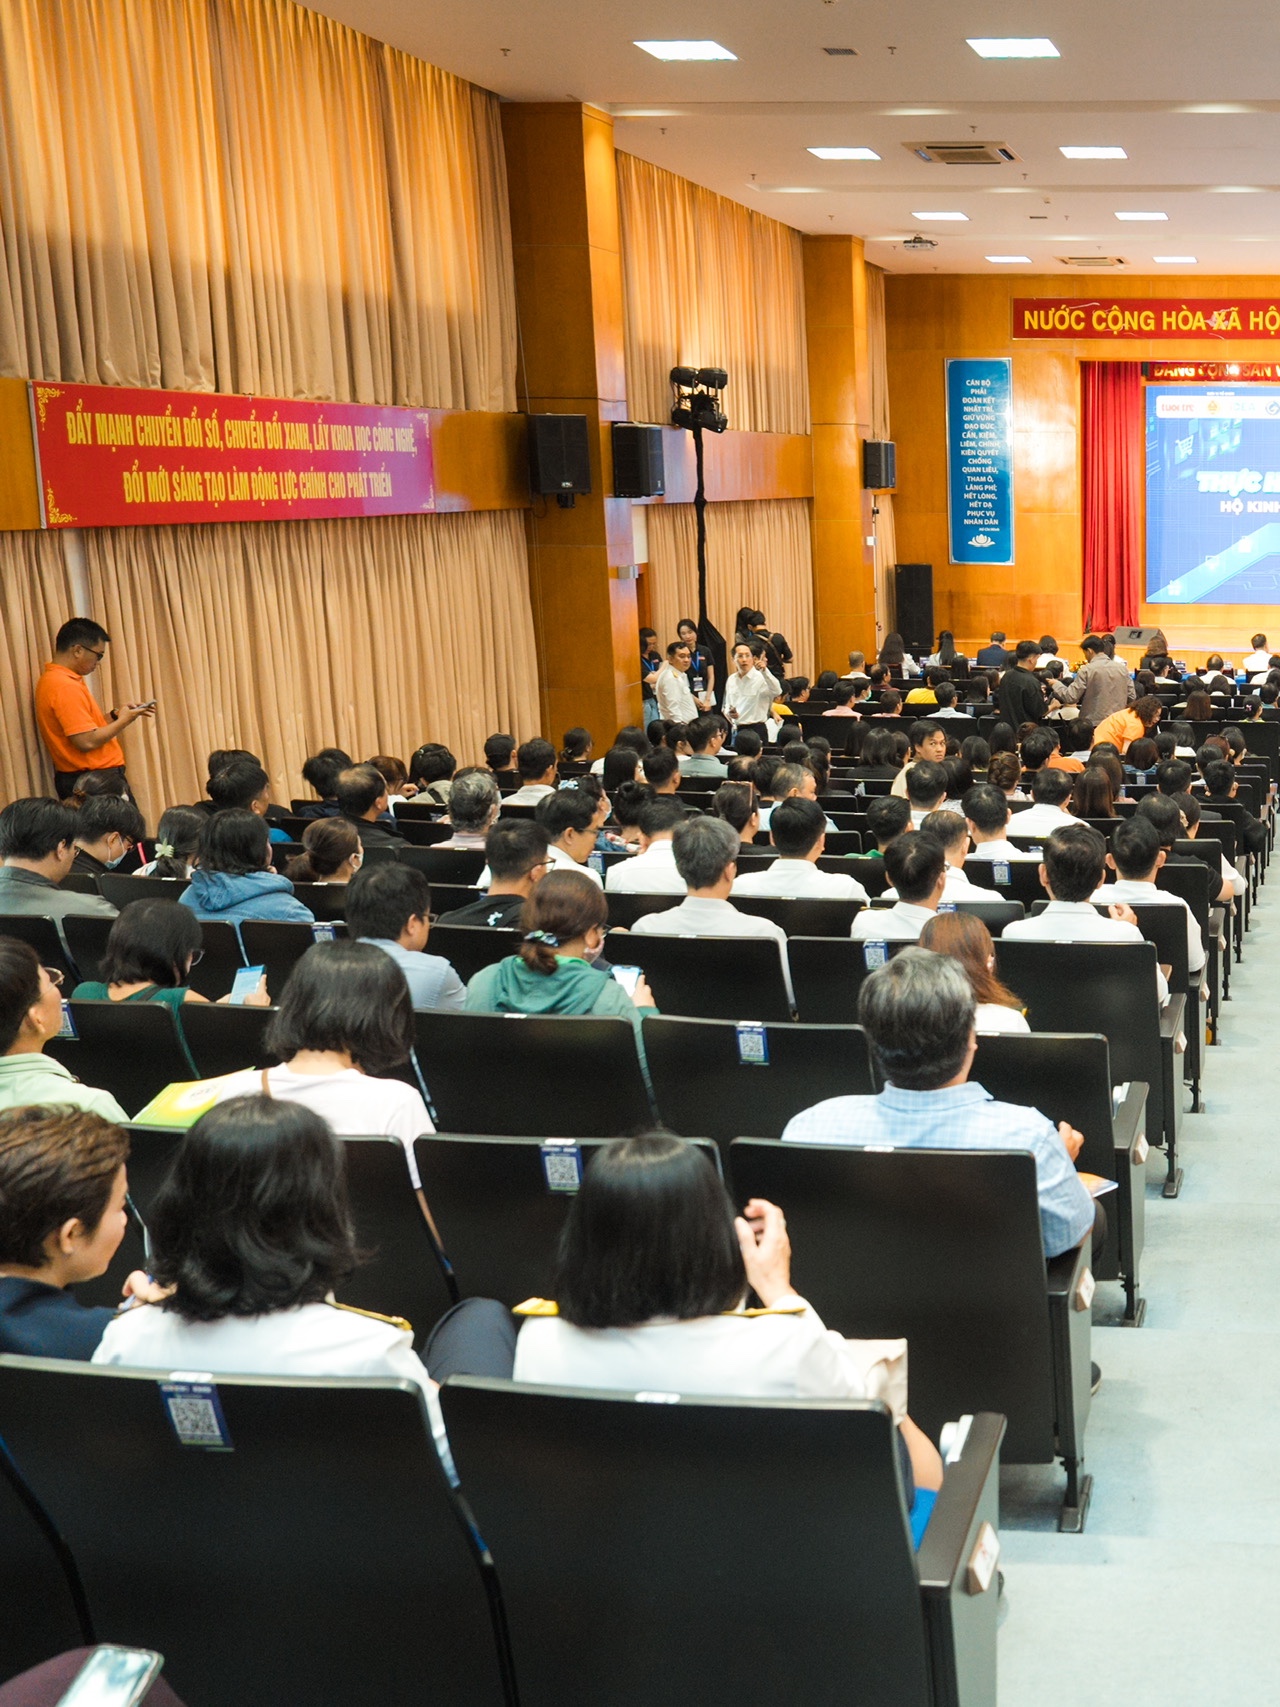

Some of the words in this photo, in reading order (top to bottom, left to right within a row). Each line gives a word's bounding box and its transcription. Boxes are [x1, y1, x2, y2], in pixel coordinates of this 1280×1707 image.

[1023, 305, 1085, 331] NƯỚC
[1091, 305, 1155, 335] CỘNG
[1162, 305, 1204, 331] HÒA
[1211, 307, 1241, 331] XÃ
[981, 379, 991, 387] BỘ
[970, 387, 987, 395] PHẢI
[963, 404, 981, 412] NHẤT
[66, 398, 92, 444] ĐẨY
[95, 412, 134, 452] MẠNH
[135, 404, 183, 447] CHUYỂN
[183, 405, 204, 447] ĐỔI
[204, 408, 224, 452] SỐ,
[224, 409, 265, 449] CHUYỂN
[265, 410, 283, 449] ĐỔI
[283, 422, 313, 453] XANH,
[313, 414, 330, 450] LẤY
[330, 424, 355, 450] KHOA
[354, 425, 372, 457] HỌC
[372, 421, 394, 451] CÔNG
[395, 423, 418, 457] NGHỆ,
[964, 423, 979, 431] ĐẠO
[962, 430, 978, 439] CẦN,
[977, 448, 999, 456] QUYẾT
[982, 466, 999, 474] LIÊU,
[987, 475, 994, 483] Ô,
[1196, 468, 1263, 497] THỰC
[123, 459, 145, 503] ĐỔI
[146, 464, 171, 502] MỚI
[172, 465, 204, 502] SÁNG
[204, 471, 226, 508] TẠO
[226, 465, 251, 501] LÀM
[251, 465, 279, 507] ĐỘNG
[279, 468, 299, 506] LỰC
[299, 465, 327, 499] CHÍNH
[328, 471, 346, 499] CHO
[346, 466, 368, 498] PHÁT
[368, 461, 392, 498] TRIỂN
[969, 500, 982, 508] HẾT
[983, 501, 992, 509] DẠ
[1220, 498, 1244, 515] HỘ
[967, 510, 985, 518] PHỤC
[985, 510, 995, 518] VỤ
